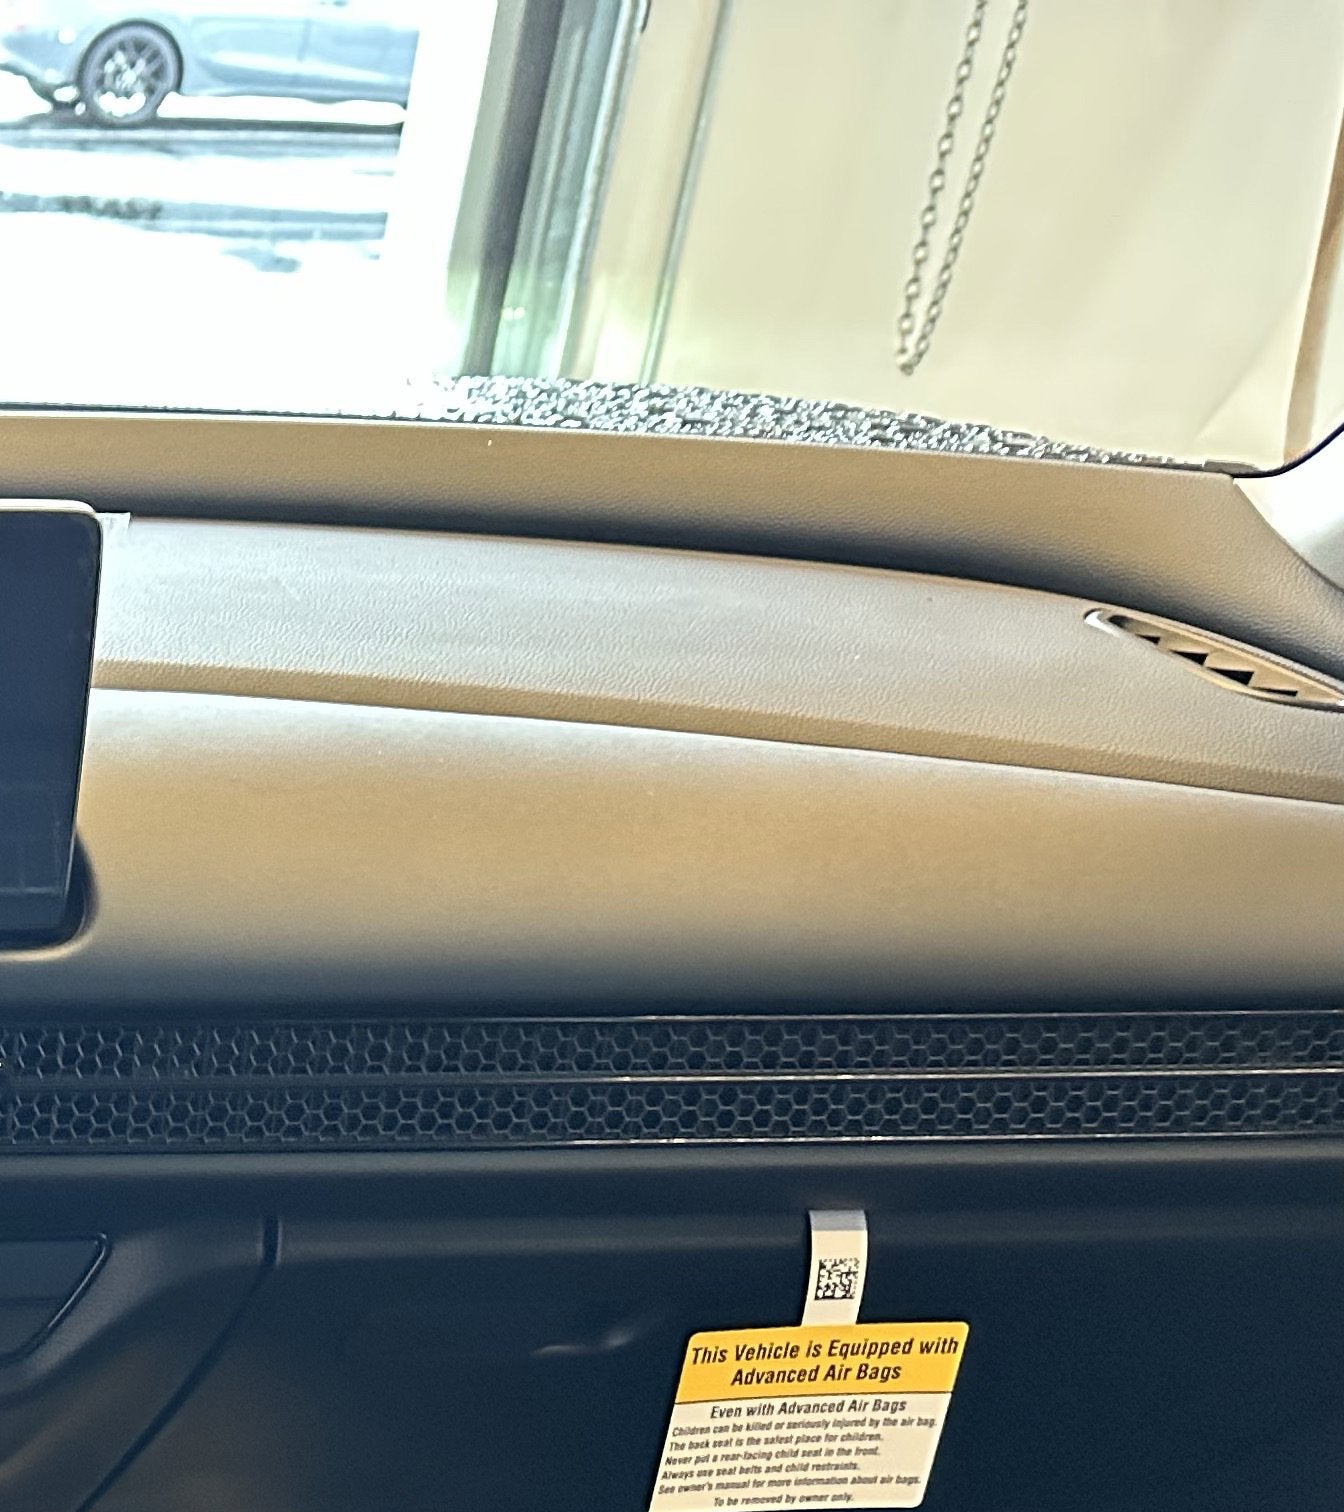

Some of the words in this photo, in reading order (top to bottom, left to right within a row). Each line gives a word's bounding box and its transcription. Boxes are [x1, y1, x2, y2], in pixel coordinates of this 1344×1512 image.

[691, 1346, 728, 1365] This
[734, 1342, 800, 1362] Vehicle
[805, 1340, 822, 1358] is
[827, 1337, 914, 1360] Equipped
[919, 1336, 959, 1355] with
[730, 1364, 820, 1387] Advanced
[823, 1364, 852, 1382] Air
[856, 1363, 903, 1383] Bags
[710, 1405, 742, 1419] Even
[746, 1403, 775, 1417] with
[777, 1400, 845, 1416] Advanced
[848, 1399, 869, 1413] Air
[872, 1399, 907, 1415] Bags
[672, 1426, 711, 1437] Children
[712, 1424, 730, 1434] can
[732, 1423, 743, 1433] be
[746, 1421, 772, 1432] killed
[774, 1421, 785, 1431] or
[786, 1419, 831, 1430] seriously
[832, 1417, 866, 1429] injured
[868, 1417, 881, 1429] by
[882, 1417, 898, 1426] the
[900, 1417, 915, 1426] air
[669, 1441, 686, 1451] The
[688, 1439, 710, 1450] back
[712, 1438, 733, 1448] seat
[735, 1437, 744, 1447] is
[746, 1436, 761, 1446] the
[763, 1434, 794, 1445] safest
[795, 1433, 822, 1445] place
[824, 1433, 839, 1443] for
[664, 1456, 693, 1466] Never
[694, 1454, 710, 1465] put
[774, 1448, 800, 1459] child
[801, 1447, 822, 1457] seat
[836, 1447, 852, 1456] the
[661, 1470, 694, 1481] Always
[715, 1466, 737, 1477] seat
[764, 1463, 783, 1474] and
[785, 1462, 809, 1472] child
[658, 1484, 676, 1495] See
[714, 1479, 751, 1490] manual
[752, 1479, 766, 1488] for
[767, 1478, 792, 1487] more
[850, 1475, 879, 1485] about
[879, 1475, 894, 1485] air
[714, 1496, 724, 1507] To
[726, 1496, 739, 1506] be
[740, 1494, 783, 1505] removed
[785, 1494, 797, 1505] by
[798, 1494, 830, 1503] owner
